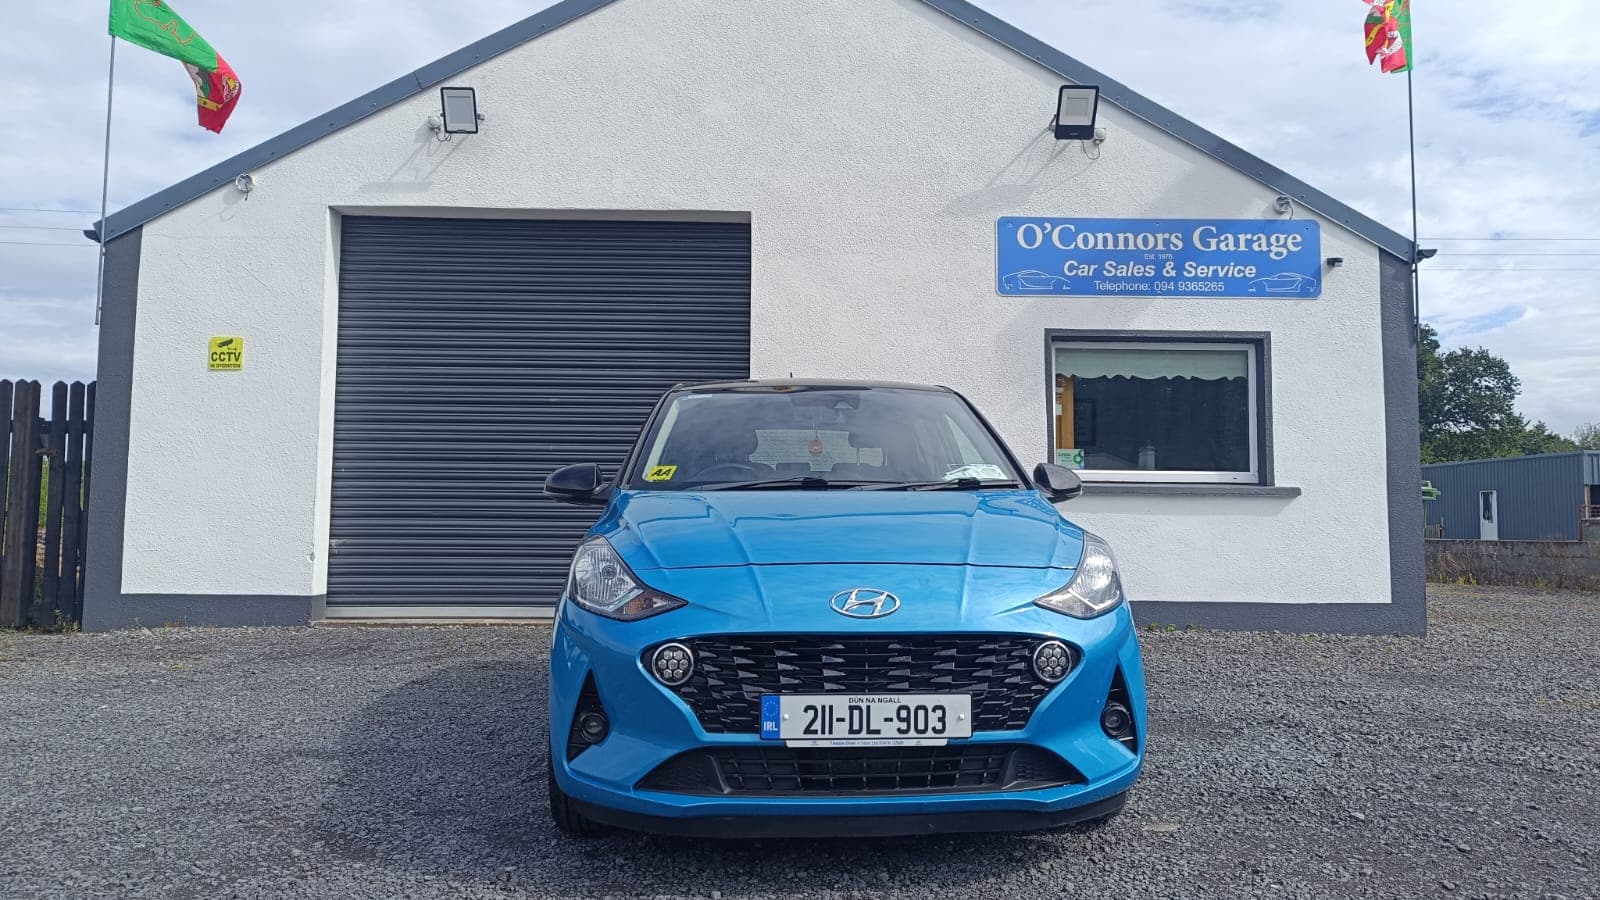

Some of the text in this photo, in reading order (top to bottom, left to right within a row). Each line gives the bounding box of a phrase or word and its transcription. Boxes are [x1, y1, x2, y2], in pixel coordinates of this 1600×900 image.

[1016, 222, 1303, 260] O'Connors Garage
[1063, 260, 1257, 278] Car Sales & Service
[1094, 280, 1225, 293] Telephone: 094 9365265
[210, 351, 241, 362] CCTV
[651, 468, 672, 477] AA
[763, 721, 778, 731] IRL
[802, 704, 947, 735] 211-DL-903
